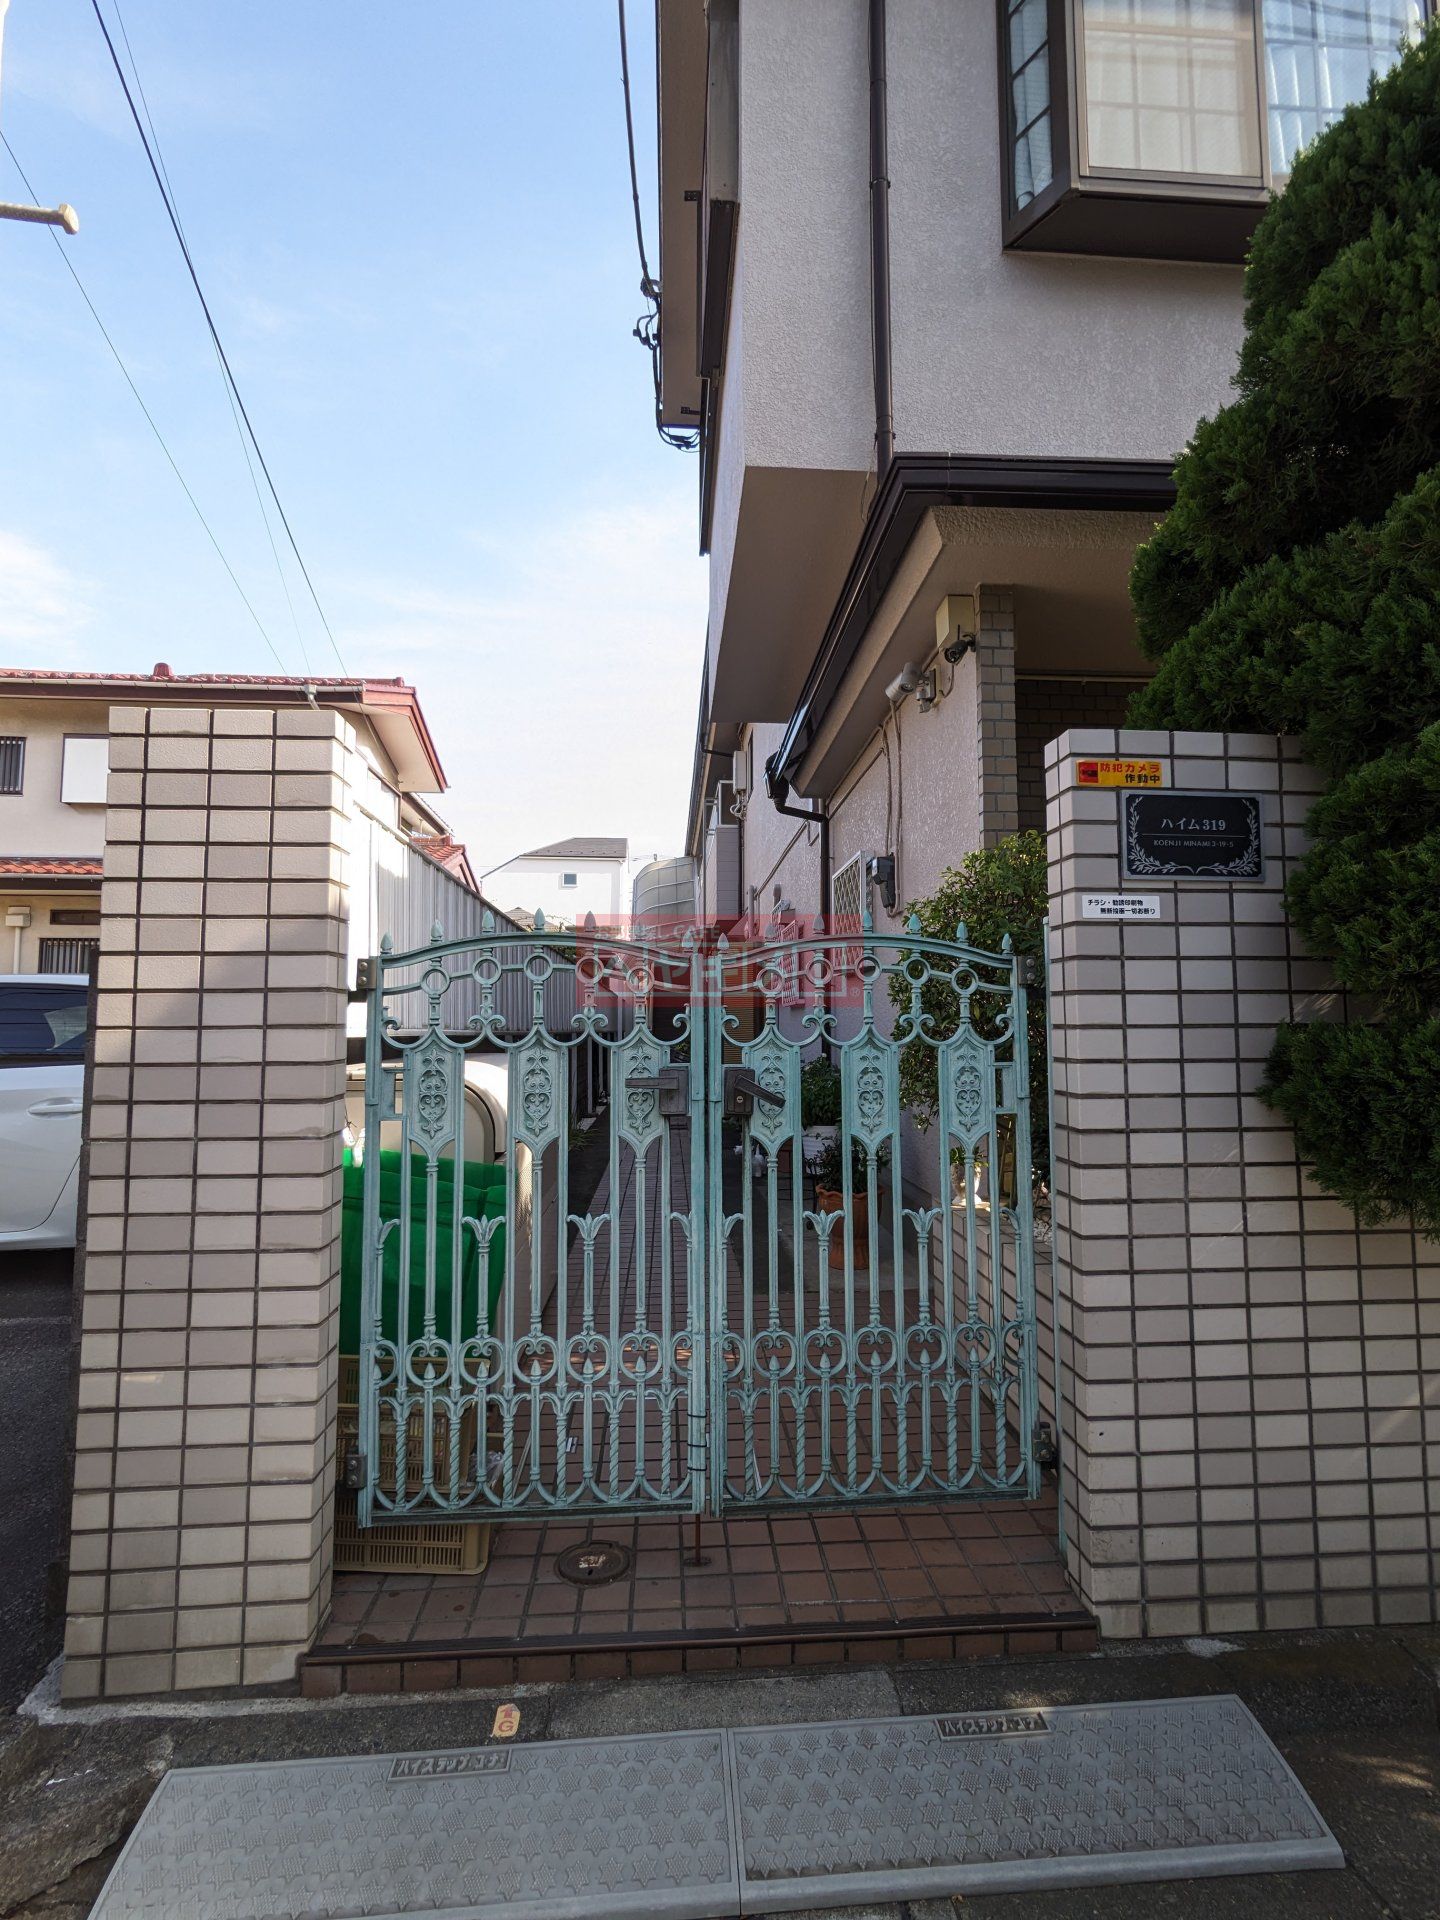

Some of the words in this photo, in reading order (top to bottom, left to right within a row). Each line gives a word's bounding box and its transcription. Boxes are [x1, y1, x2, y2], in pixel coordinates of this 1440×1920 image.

[1101, 763, 1160, 774] 防犯カメラ
[1125, 773, 1160, 784] 作動中
[1153, 839, 1181, 847] KOENJI
[498, 1720, 514, 1733] G
